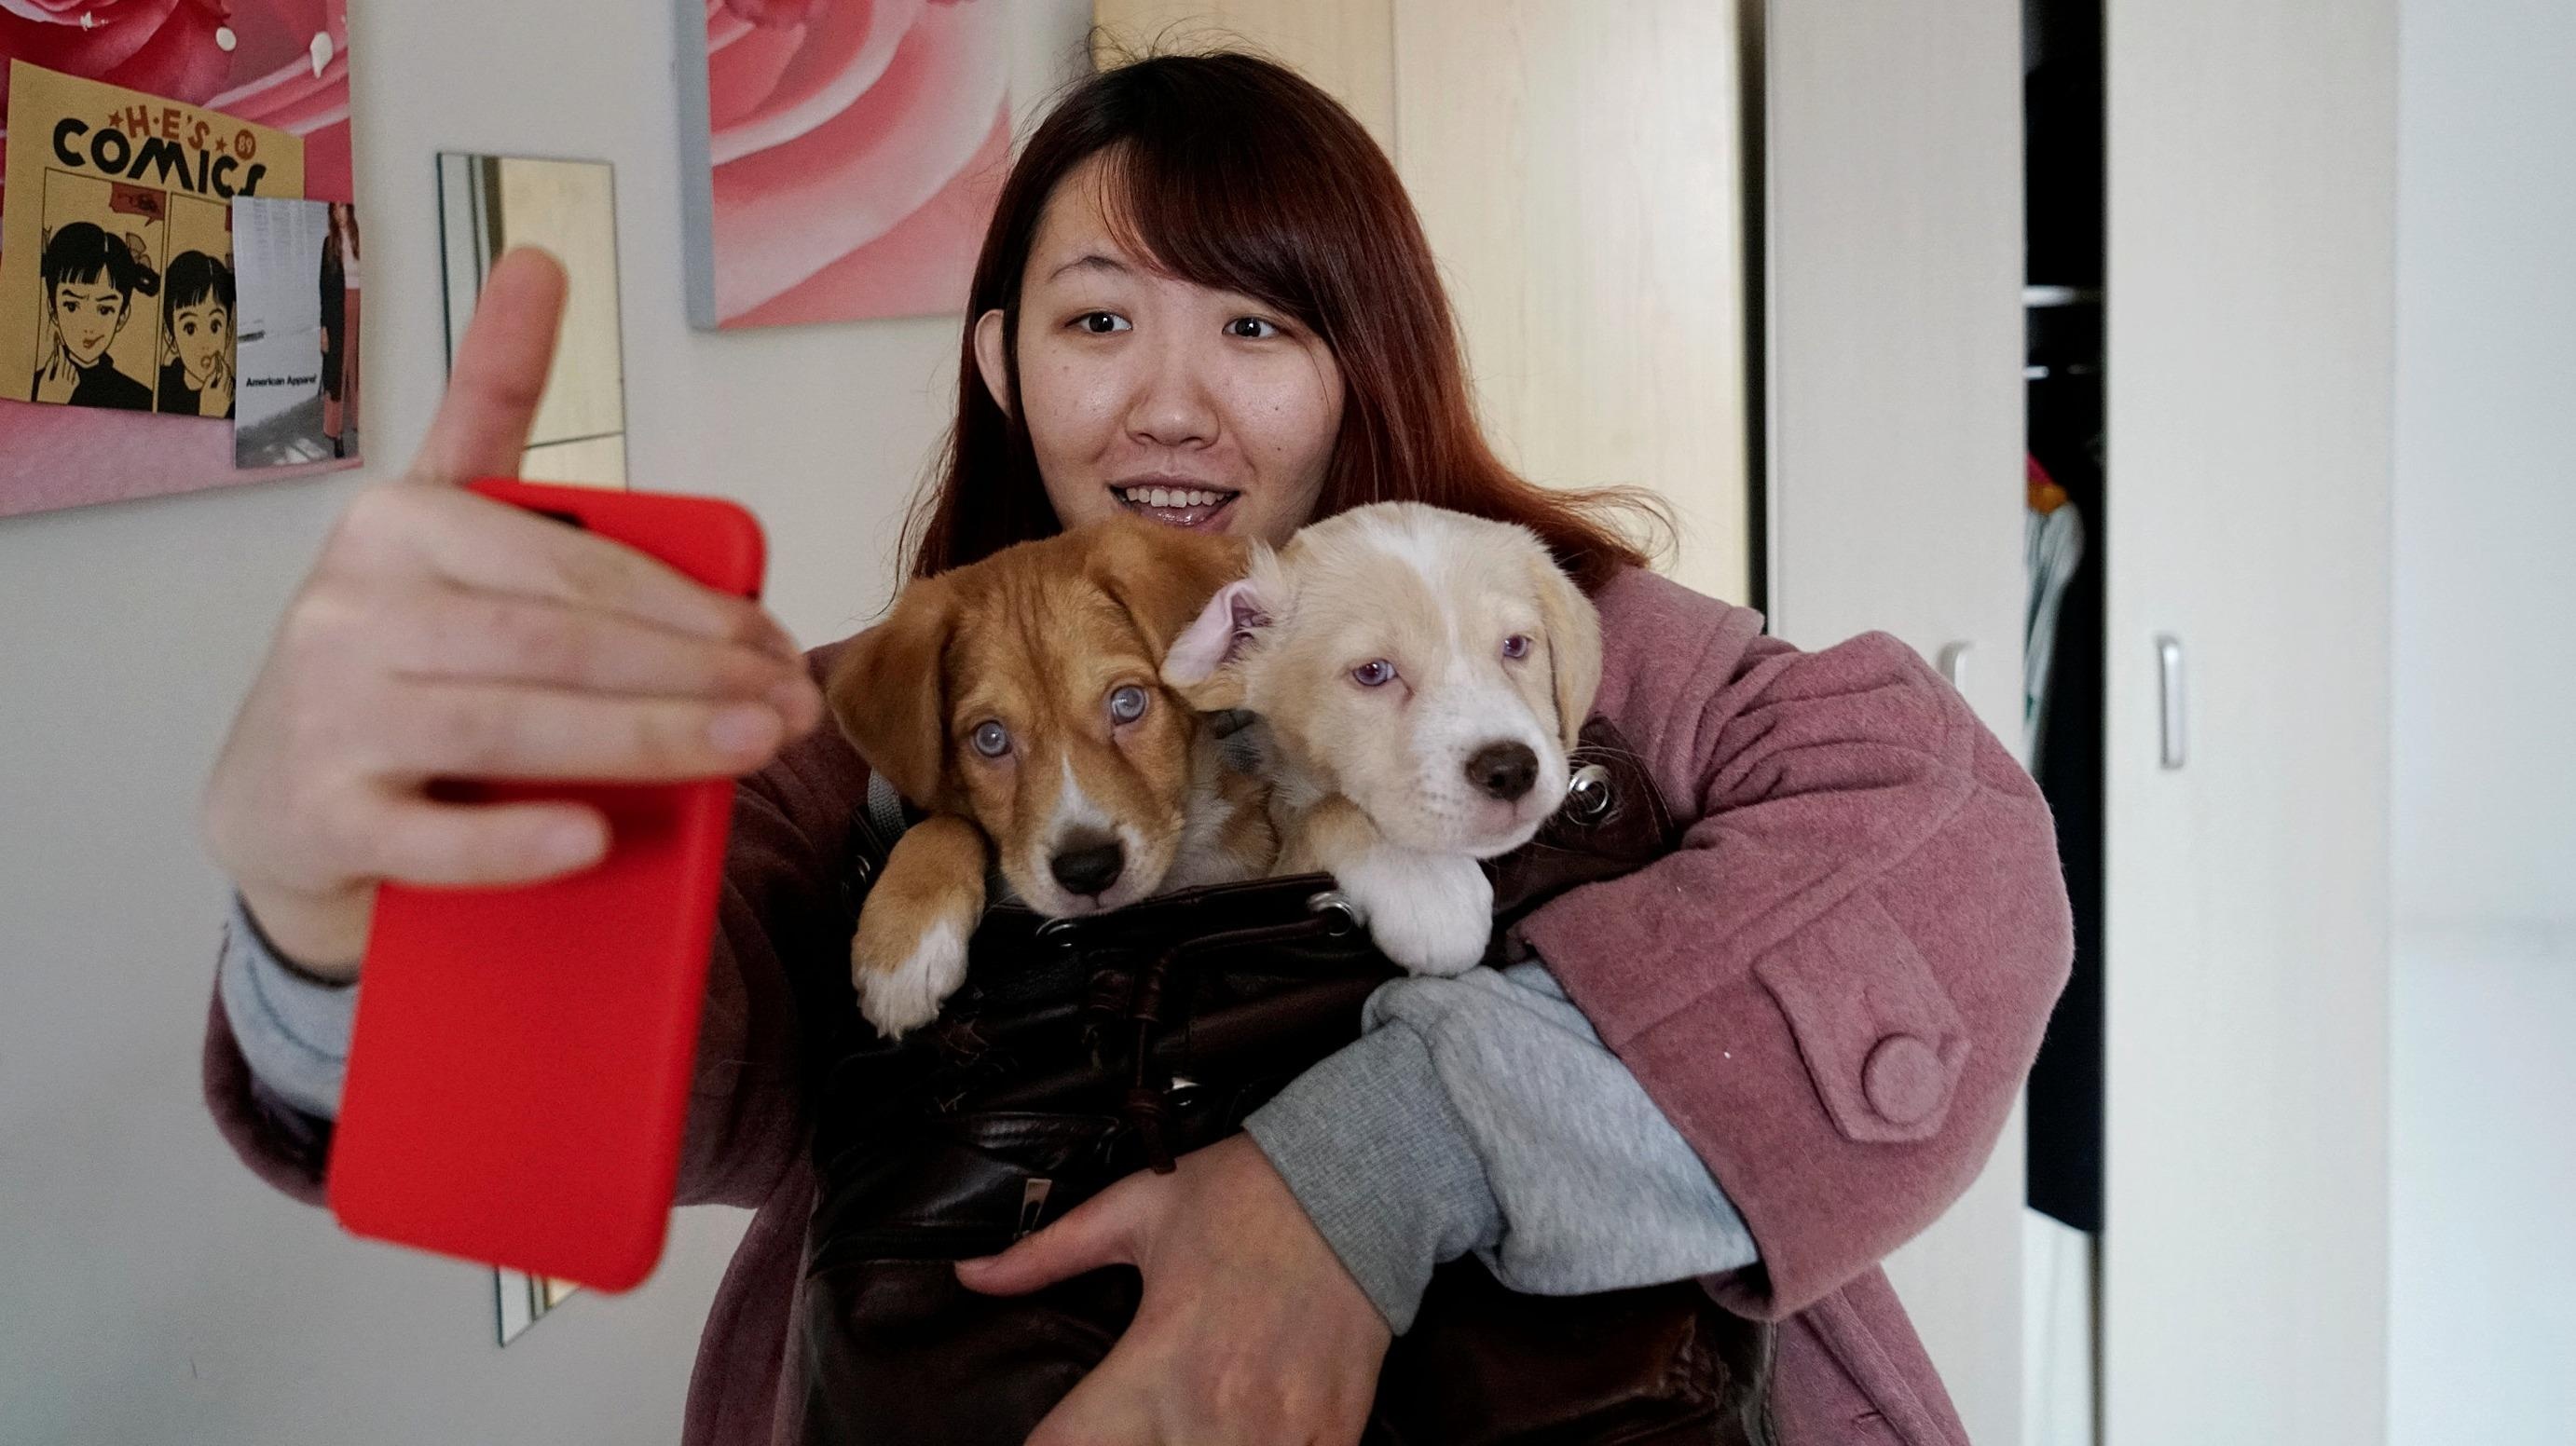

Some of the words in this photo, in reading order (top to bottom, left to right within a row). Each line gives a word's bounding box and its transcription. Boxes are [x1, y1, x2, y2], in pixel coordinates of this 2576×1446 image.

[237, 135, 253, 154] 89
[52, 117, 267, 198] COMICS
[245, 376, 285, 388] American
